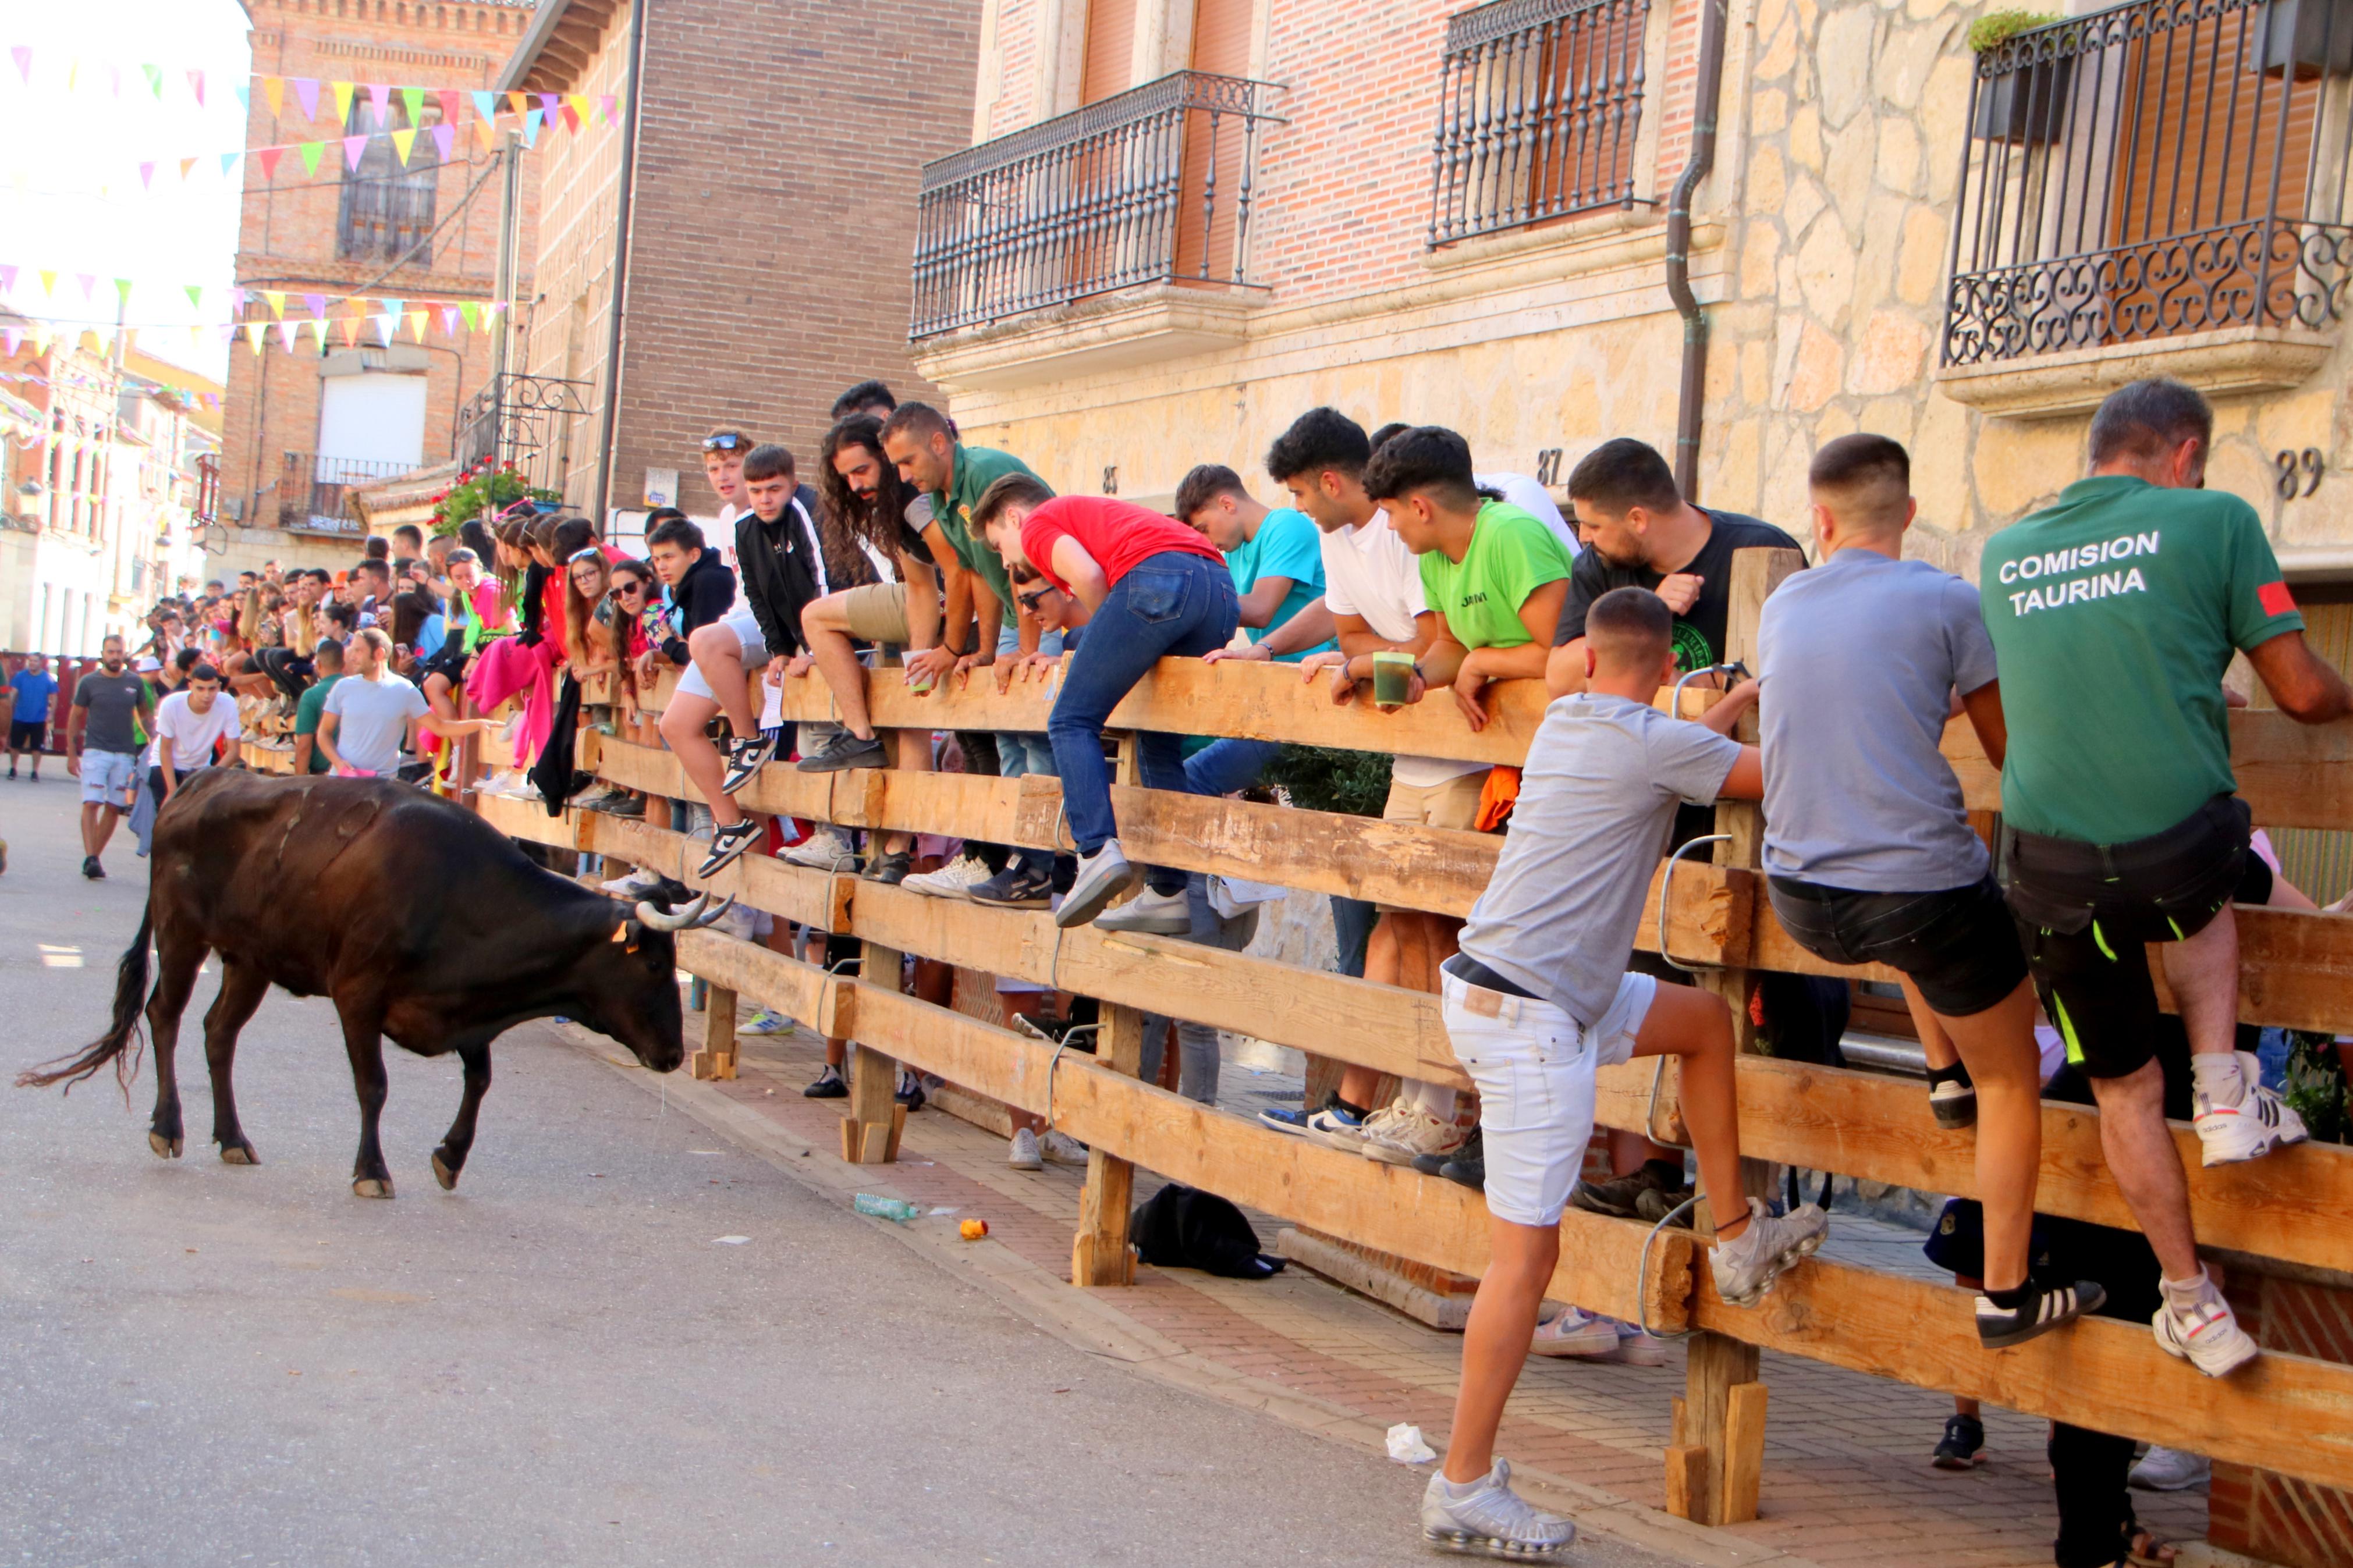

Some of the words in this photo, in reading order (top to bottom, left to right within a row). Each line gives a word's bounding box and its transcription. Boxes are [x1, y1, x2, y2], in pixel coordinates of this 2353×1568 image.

[1537, 448, 1563, 485] 87
[2276, 447, 2323, 500] 89
[1999, 531, 2159, 584] COMISION
[2009, 567, 2146, 617] TAURINA
[2203, 1123, 2227, 1132] adidas
[2206, 1328, 2227, 1343] adidas
